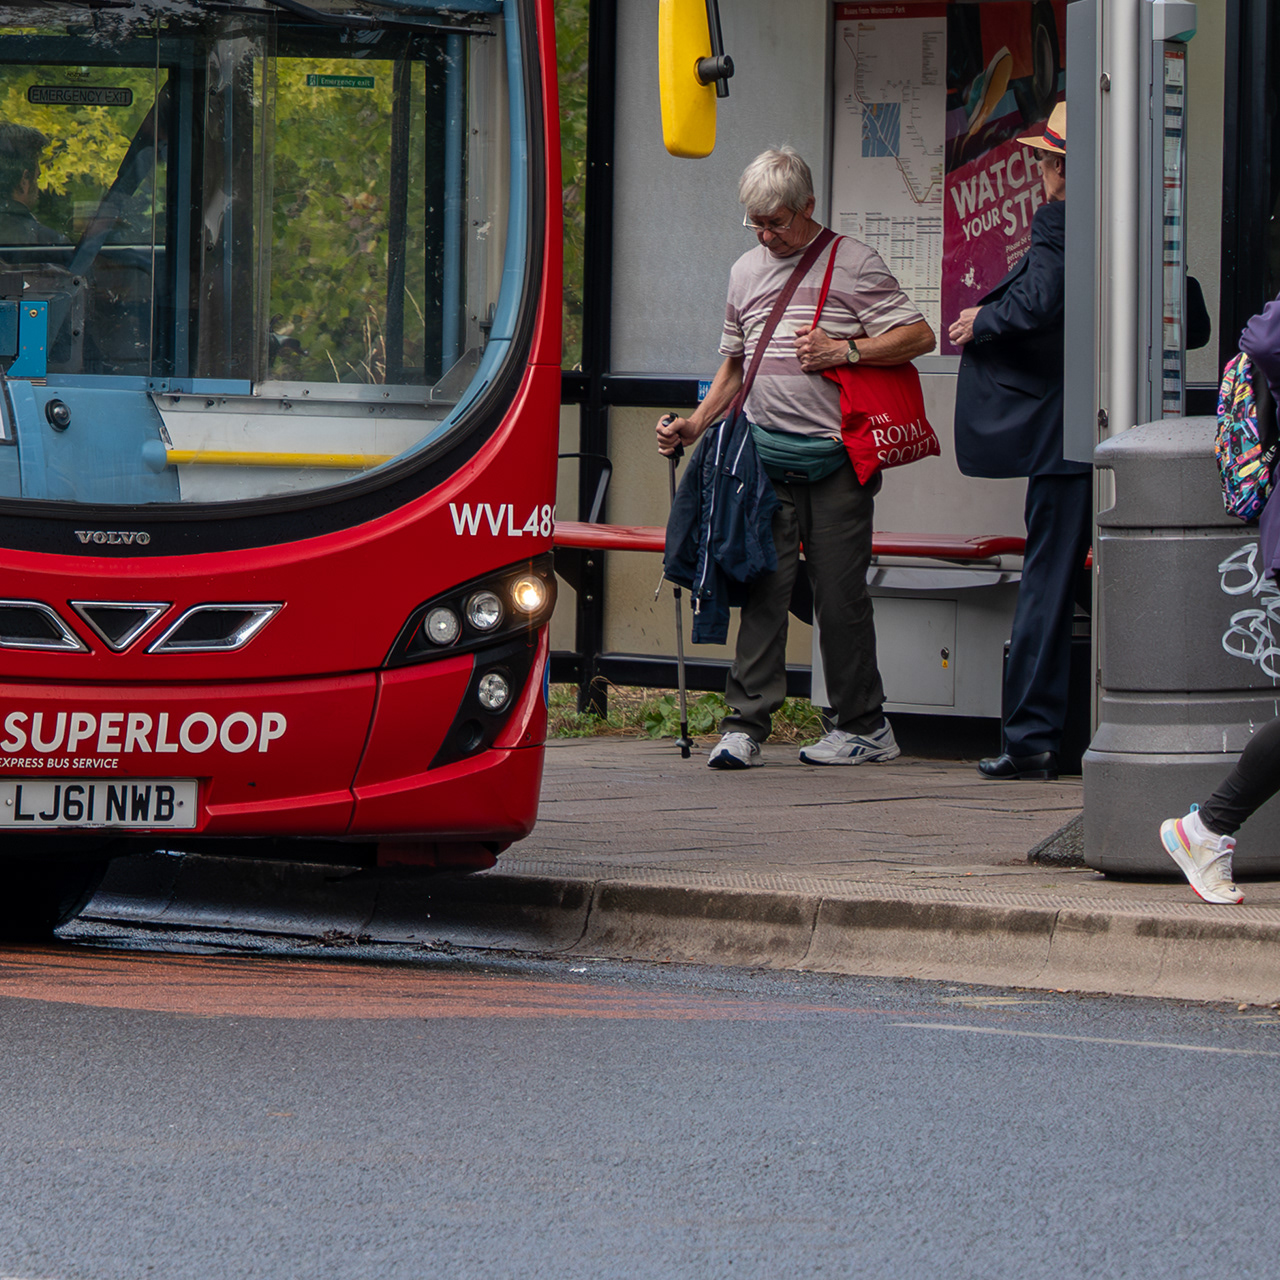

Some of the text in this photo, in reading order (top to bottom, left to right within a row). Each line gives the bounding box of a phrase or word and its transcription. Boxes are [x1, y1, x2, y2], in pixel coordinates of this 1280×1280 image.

[321, 78, 355, 86] Emergency
[32, 89, 129, 103] EMERGENCY EXIT
[962, 207, 1001, 241] YOUR
[868, 412, 892, 425] THE
[871, 419, 926, 447] ROYAL
[74, 531, 150, 545] VOLVO
[0, 711, 287, 754] SUPERLOOP
[46, 758, 69, 768] BUS
[72, 758, 119, 769] SERVICE
[14, 784, 176, 821] LJ61 NWB
